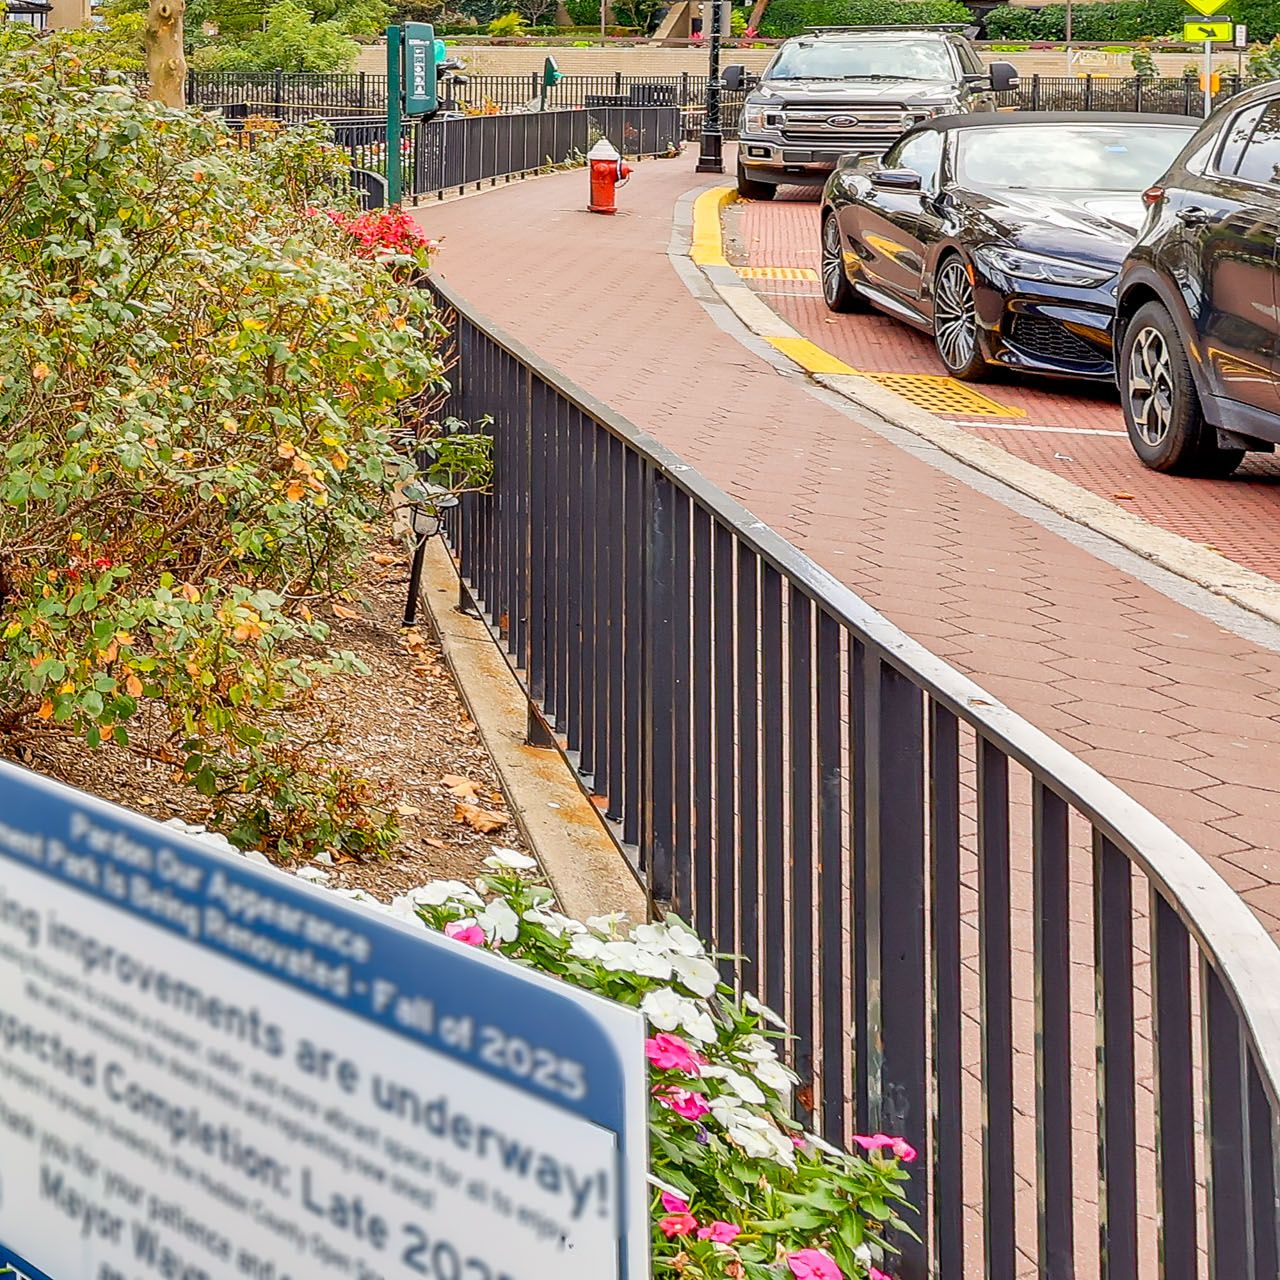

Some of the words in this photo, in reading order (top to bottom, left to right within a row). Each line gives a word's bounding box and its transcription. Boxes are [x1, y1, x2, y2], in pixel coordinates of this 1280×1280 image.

[46, 839, 100, 885] Park
[130, 876, 201, 941] Being
[203, 906, 350, 998] Renovated
[370, 978, 435, 1034] Fall
[438, 1014, 475, 1050] of
[478, 1024, 589, 1102] 2025
[156, 848, 204, 891] Our
[205, 871, 372, 963] Appearance
[46, 910, 285, 1059] improvements
[294, 1039, 360, 1095] are
[371, 1074, 611, 1220] underway!
[102, 1060, 294, 1200] Completion:
[299, 1168, 390, 1252] Late
[401, 1222, 516, 1280] 20
[39, 1162, 126, 1246] Mayor
